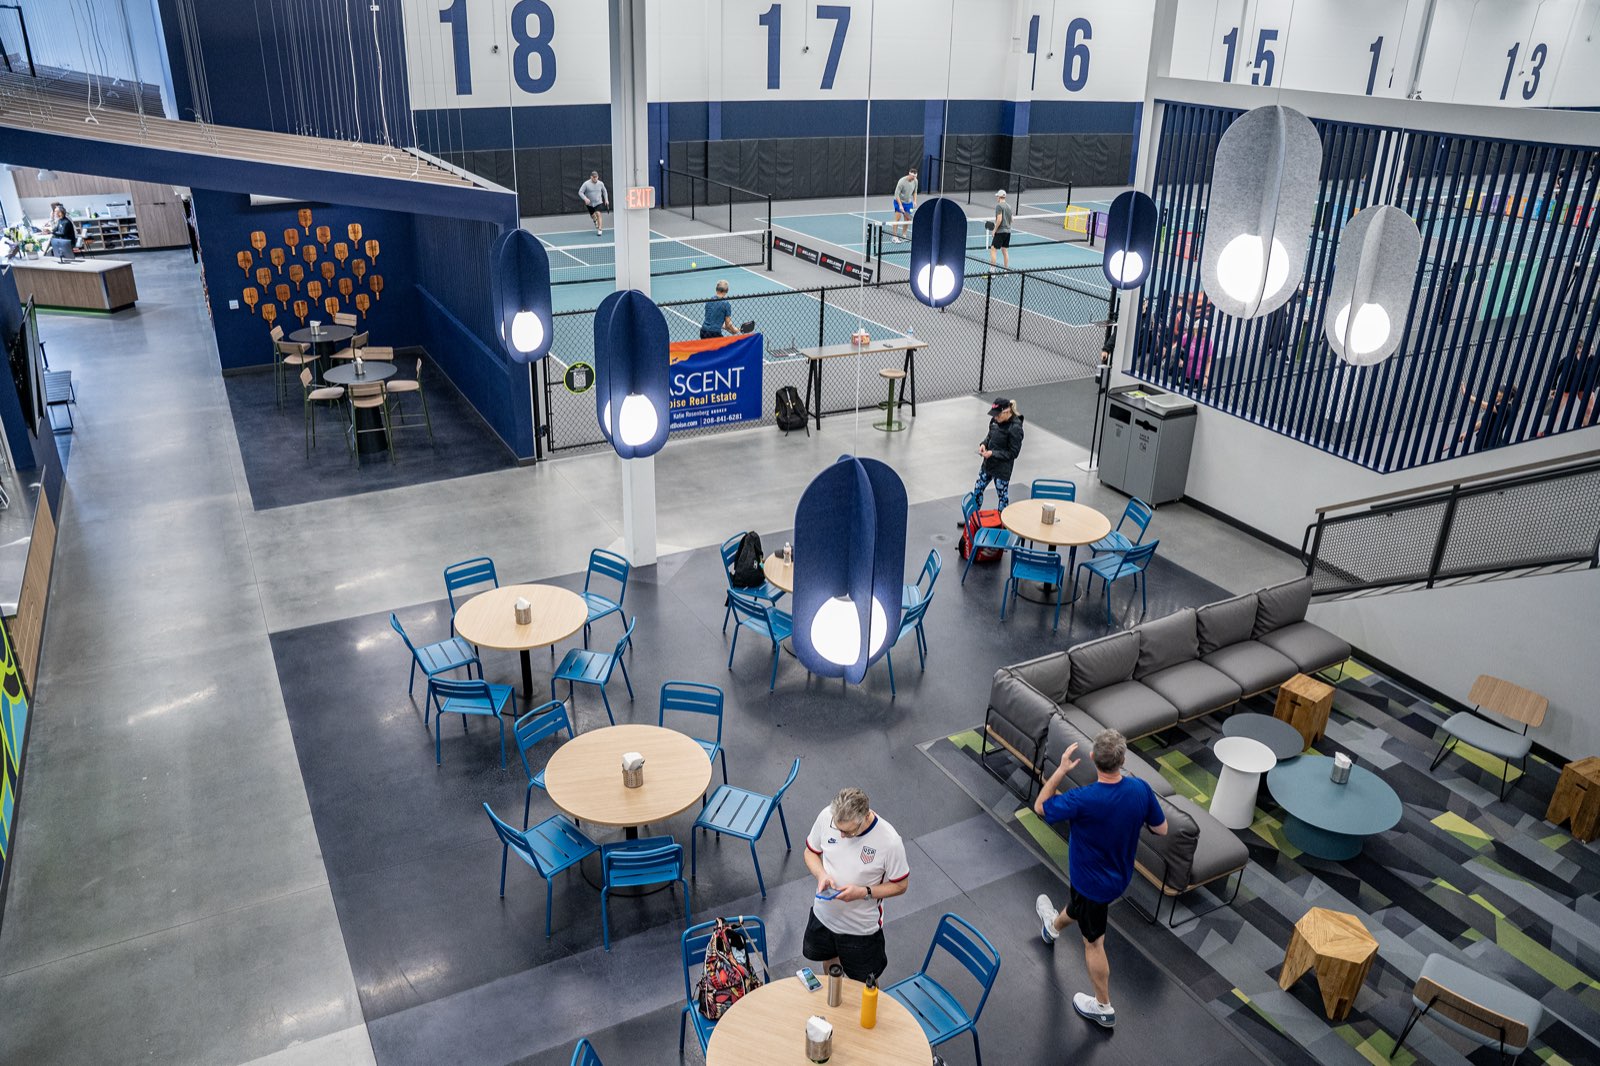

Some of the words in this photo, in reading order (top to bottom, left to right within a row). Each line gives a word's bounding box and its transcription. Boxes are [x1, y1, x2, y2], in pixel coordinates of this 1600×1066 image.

[440, 0, 556, 95] 18
[759, 4, 851, 90] 17
[1027, 14, 1093, 92] 16
[1222, 27, 1279, 87] 15
[1365, 36, 1395, 96] 1
[1500, 42, 1548, 101] 13
[630, 188, 653, 208] EXIT
[669, 366, 745, 397] SCENT
[689, 395, 708, 406] Real
[711, 391, 737, 403] Estate
[703, 414, 742, 425] 208-841-6281
